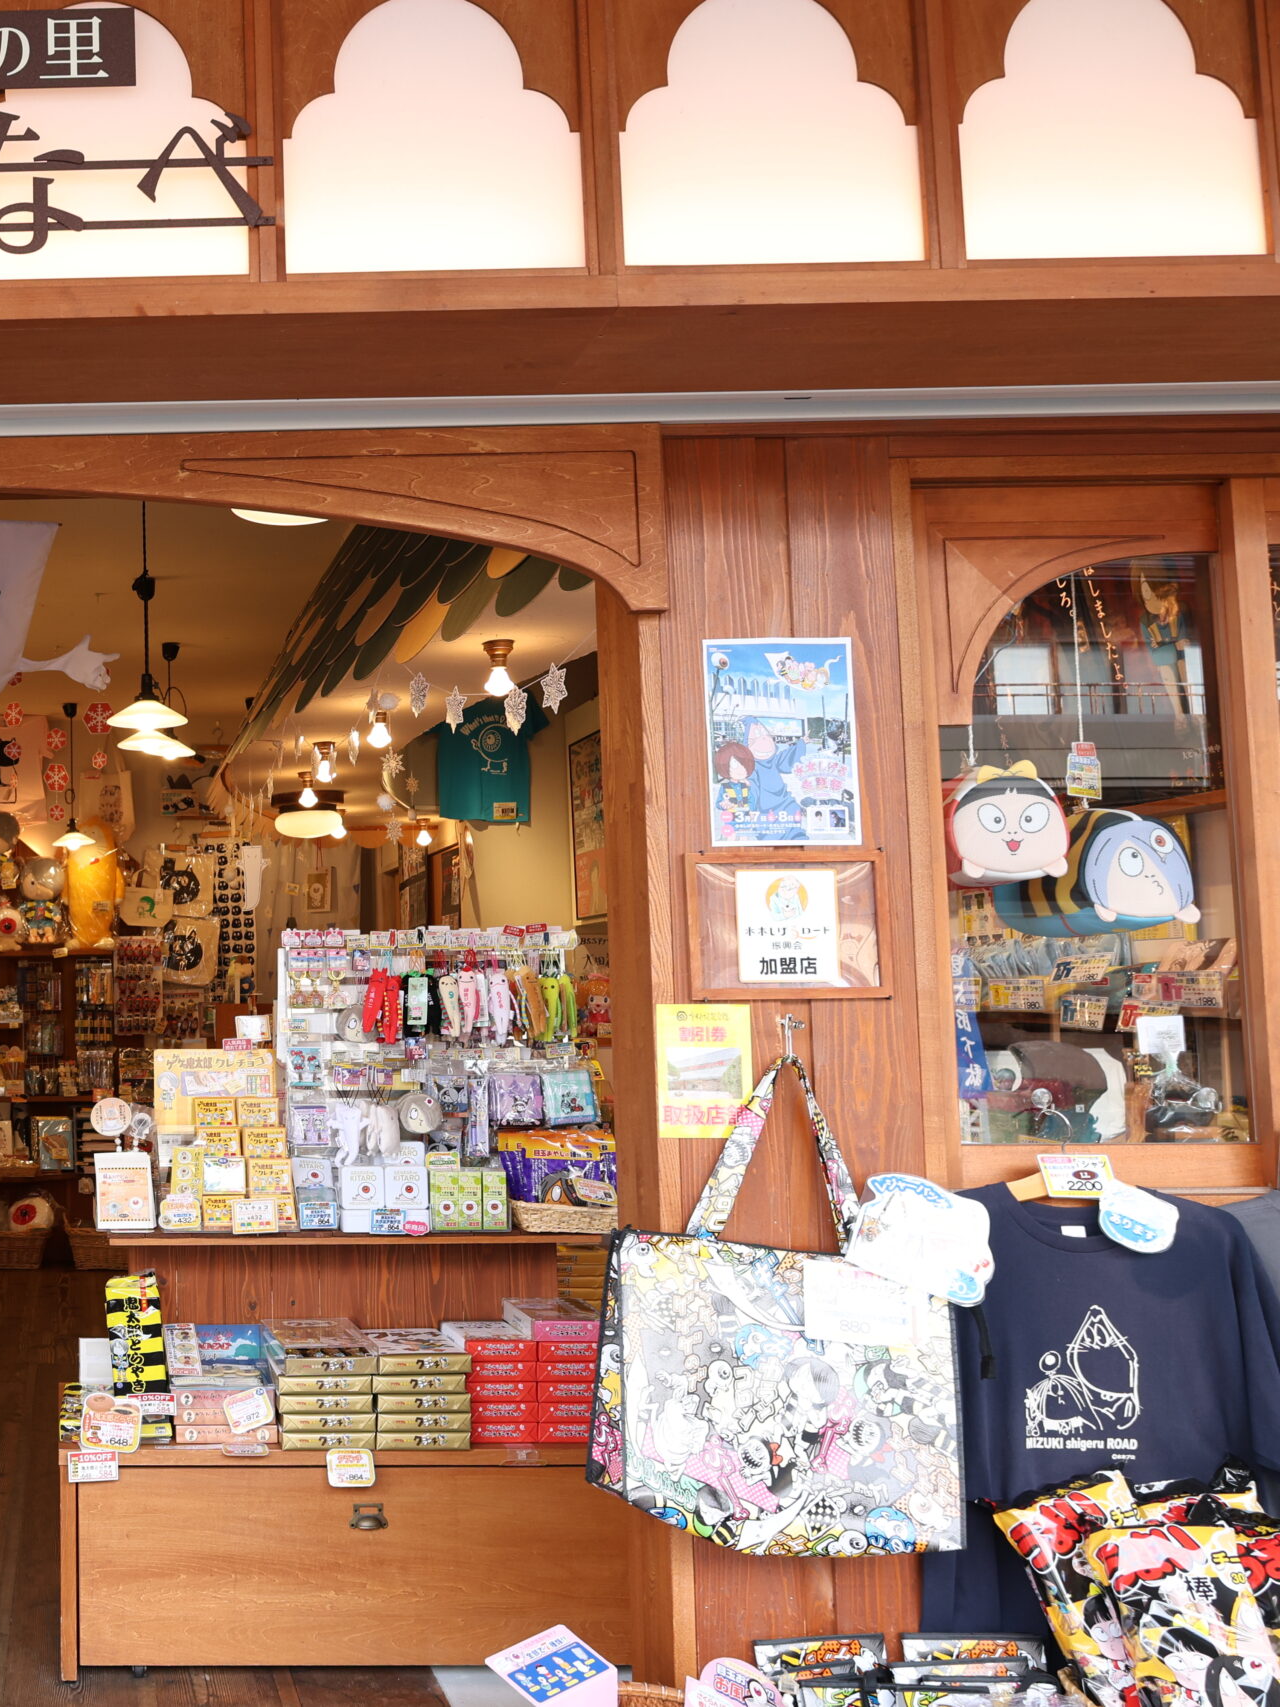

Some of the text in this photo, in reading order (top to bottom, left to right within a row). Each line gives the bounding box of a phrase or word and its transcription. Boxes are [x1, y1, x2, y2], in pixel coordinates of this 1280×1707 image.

[759, 956, 818, 975] 加盟店
[678, 1026, 727, 1043] 割引券
[839, 1319, 871, 1334] 880
[1025, 1437, 1139, 1452] MIZUKI shigeru ROAD
[79, 1453, 113, 1462] 10%OFF
[1230, 1572, 1246, 1585] 30
[1183, 1576, 1217, 1601] 棒
